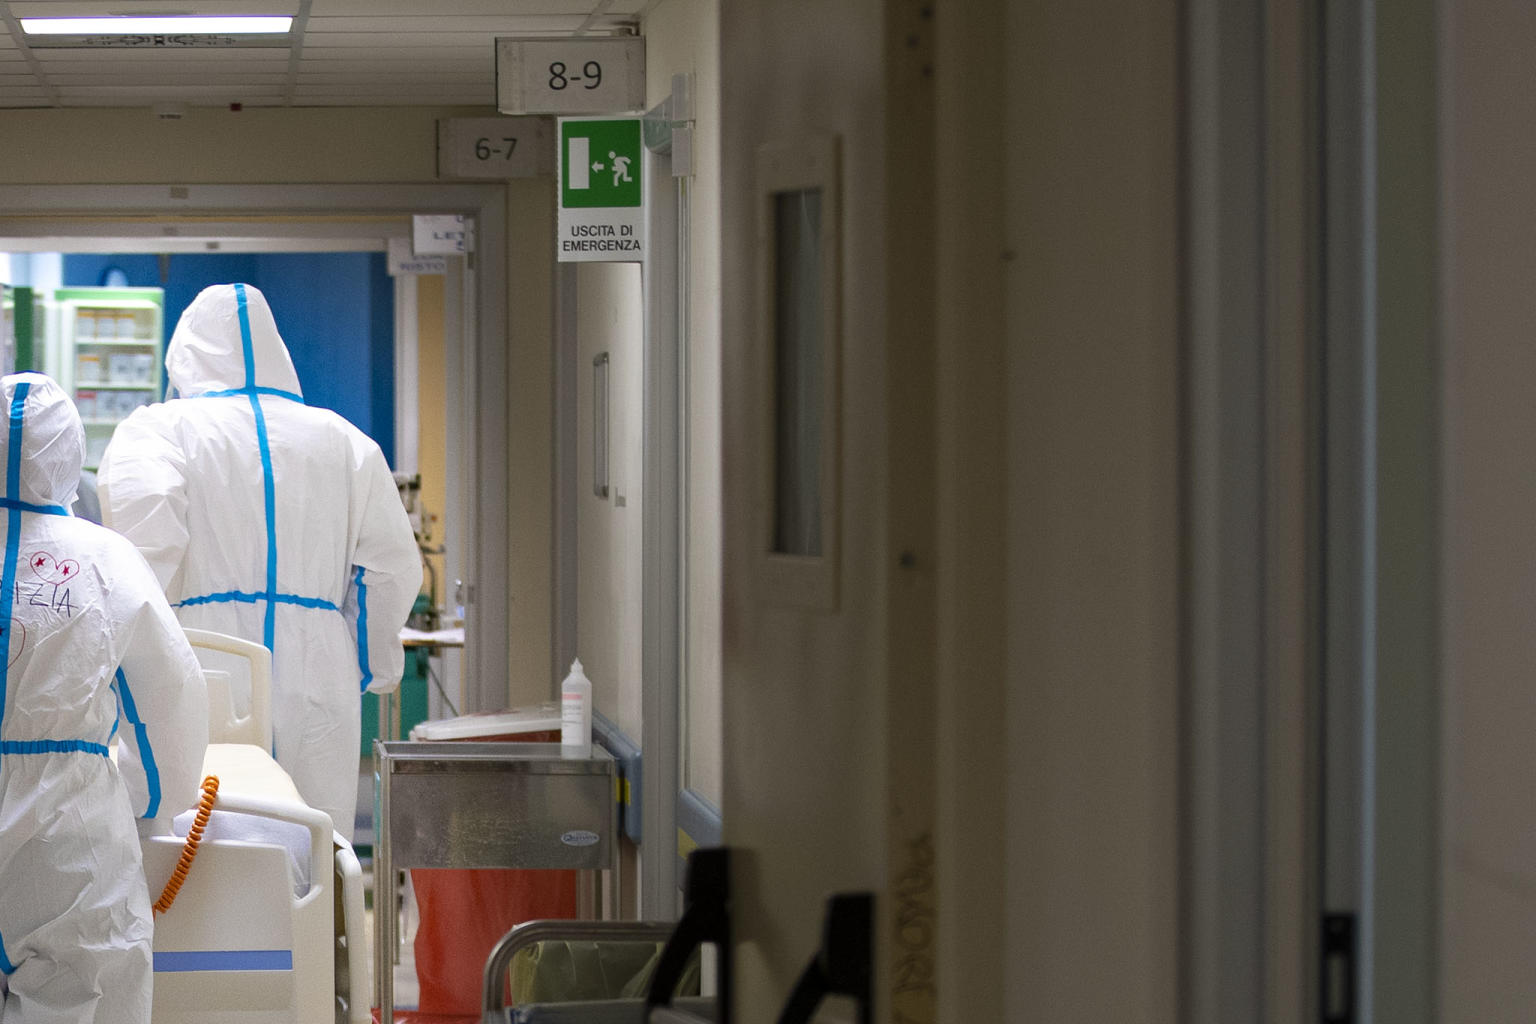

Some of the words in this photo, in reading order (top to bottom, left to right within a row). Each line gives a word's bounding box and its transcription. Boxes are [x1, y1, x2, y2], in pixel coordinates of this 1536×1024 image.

[549, 61, 602, 90] 8-9
[475, 138, 518, 160] 6-7
[571, 225, 616, 237] USCITA
[620, 225, 633, 236] DI
[563, 240, 641, 251] EMERGENZA
